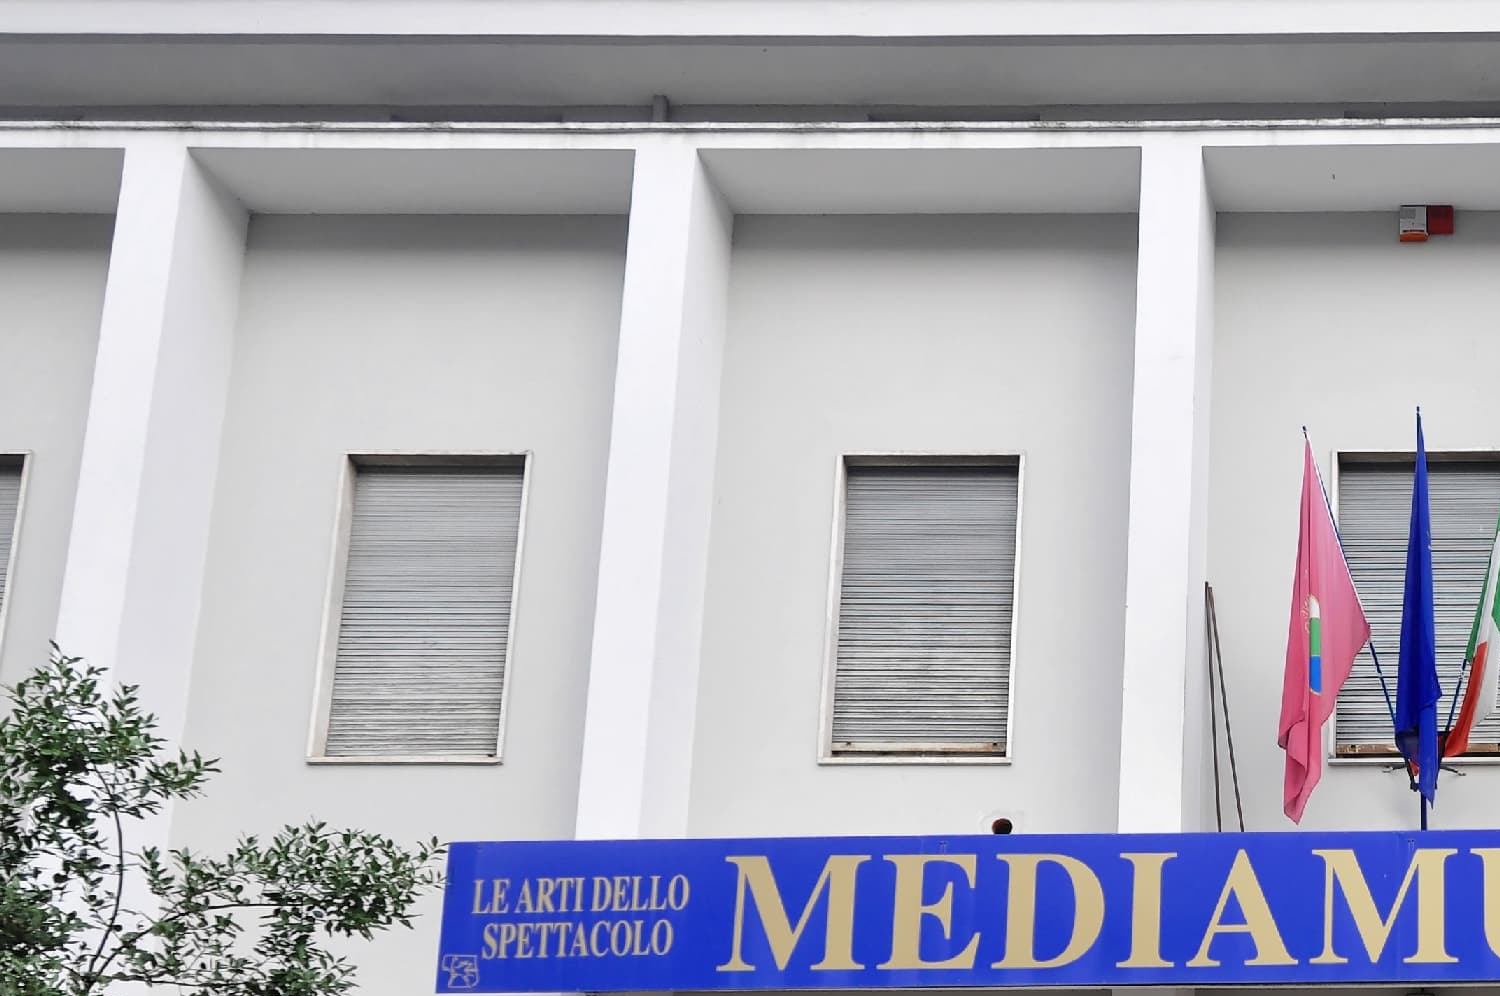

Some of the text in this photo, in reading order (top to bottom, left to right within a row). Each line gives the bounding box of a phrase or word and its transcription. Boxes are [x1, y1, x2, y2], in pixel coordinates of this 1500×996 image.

[472, 874, 691, 914] LE ARTI DELLO
[481, 919, 674, 960] SPETTACOLO
